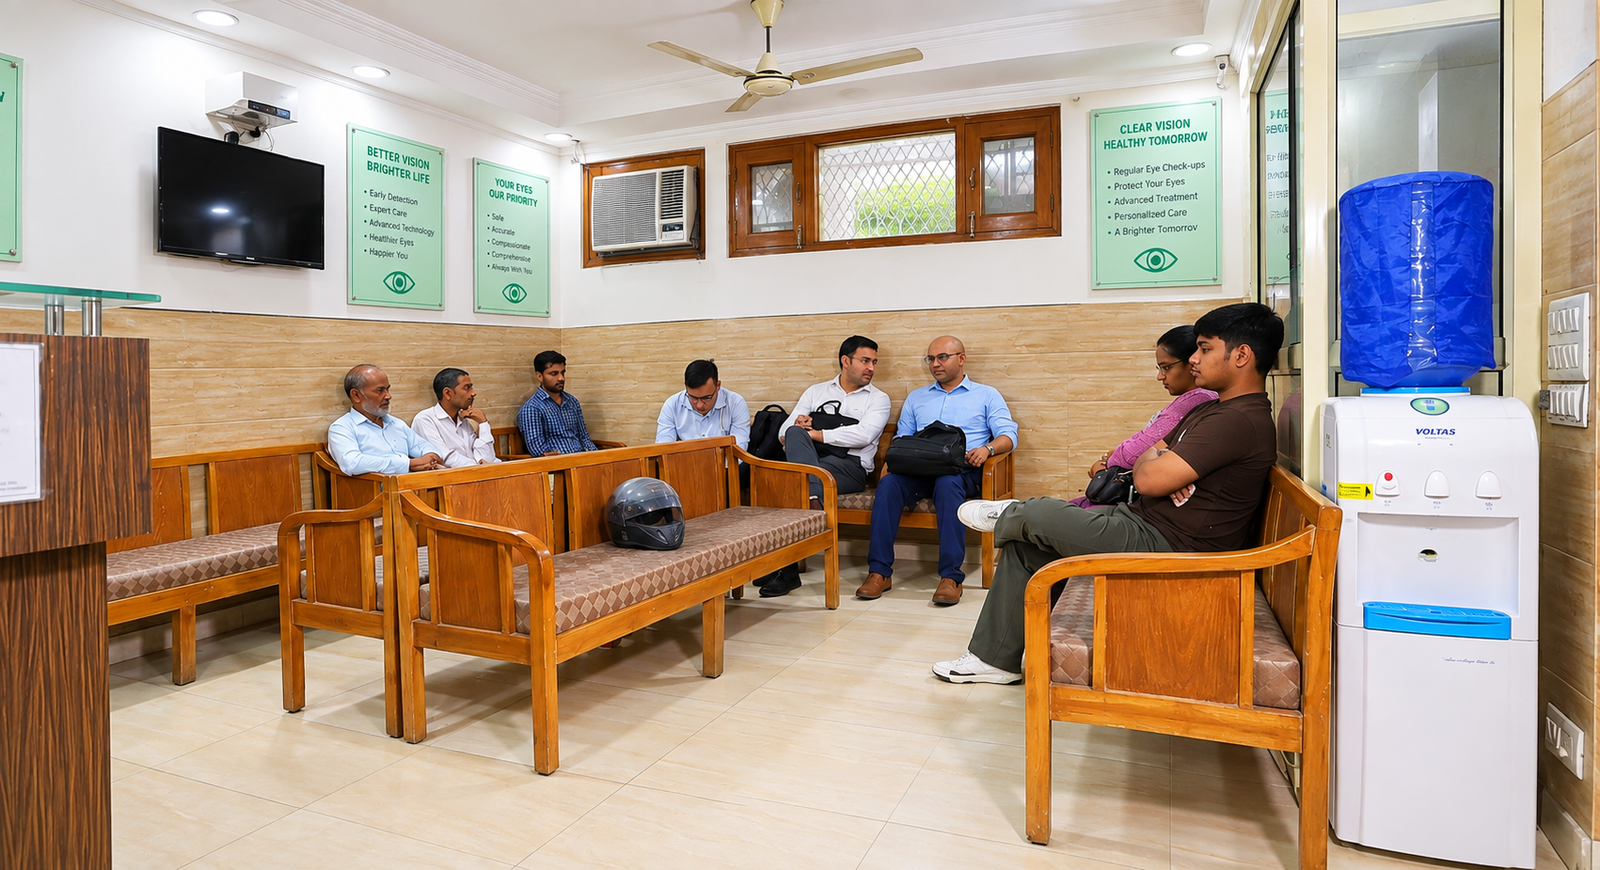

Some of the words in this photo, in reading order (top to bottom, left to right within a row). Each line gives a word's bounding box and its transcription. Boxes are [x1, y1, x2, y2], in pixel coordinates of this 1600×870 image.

[1120, 122, 1152, 134] CLEAR
[1155, 118, 1190, 131] VISION
[1103, 137, 1146, 150] HEALTHY
[1148, 131, 1208, 146] TOMORROW
[367, 145, 400, 163] BETTER
[402, 154, 430, 170] VISION
[367, 160, 411, 180] BRIGHTER
[412, 171, 430, 184] LIFE
[1113, 166, 1144, 177] Regular
[1146, 164, 1160, 174] Eye
[1162, 161, 1206, 172] Check-ups
[495, 177, 515, 190] YOUR
[516, 183, 533, 194] EYES
[1114, 182, 1143, 191] Protect
[1145, 180, 1163, 188] Your
[1166, 178, 1186, 188] Eyes
[370, 189, 386, 200] Early
[388, 192, 418, 205] Detection
[489, 189, 504, 200] OUR
[506, 192, 538, 207] PRIORITY
[1114, 195, 1154, 206] Advanced
[1156, 192, 1198, 202] Treatment
[370, 203, 391, 214] Expert
[392, 208, 407, 217] Care
[1114, 209, 1166, 221] Personalized
[1168, 208, 1188, 217] Care
[370, 219, 400, 230] Advanced
[1114, 228, 1121, 236] A
[1122, 226, 1155, 237] Brighter
[400, 237, 414, 247] Eyes
[370, 248, 395, 258] Happier
[396, 251, 409, 260] You
[1415, 428, 1456, 436] VOLTAS
